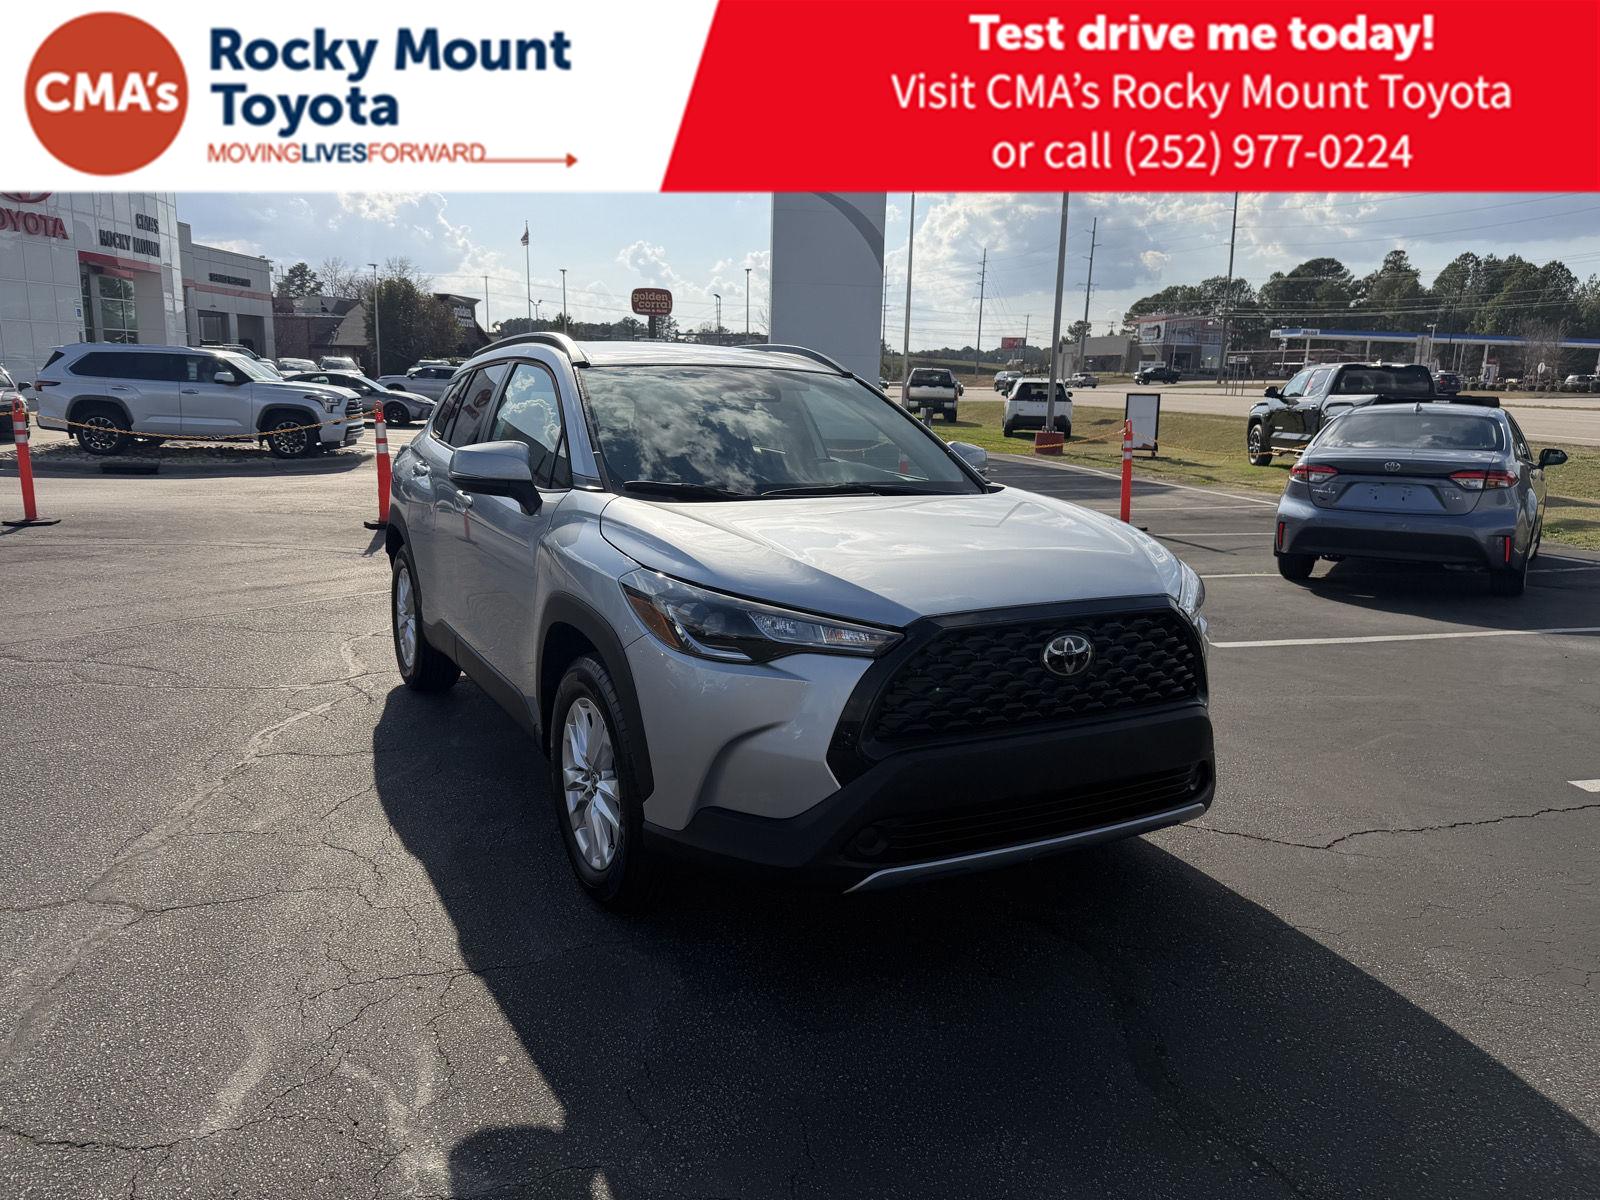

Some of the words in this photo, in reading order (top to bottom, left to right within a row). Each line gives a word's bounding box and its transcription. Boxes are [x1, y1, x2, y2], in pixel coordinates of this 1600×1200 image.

[0, 207, 69, 240] OYOTA
[99, 229, 131, 251] ROCKY
[632, 292, 668, 302] golden
[638, 301, 672, 309] corral
